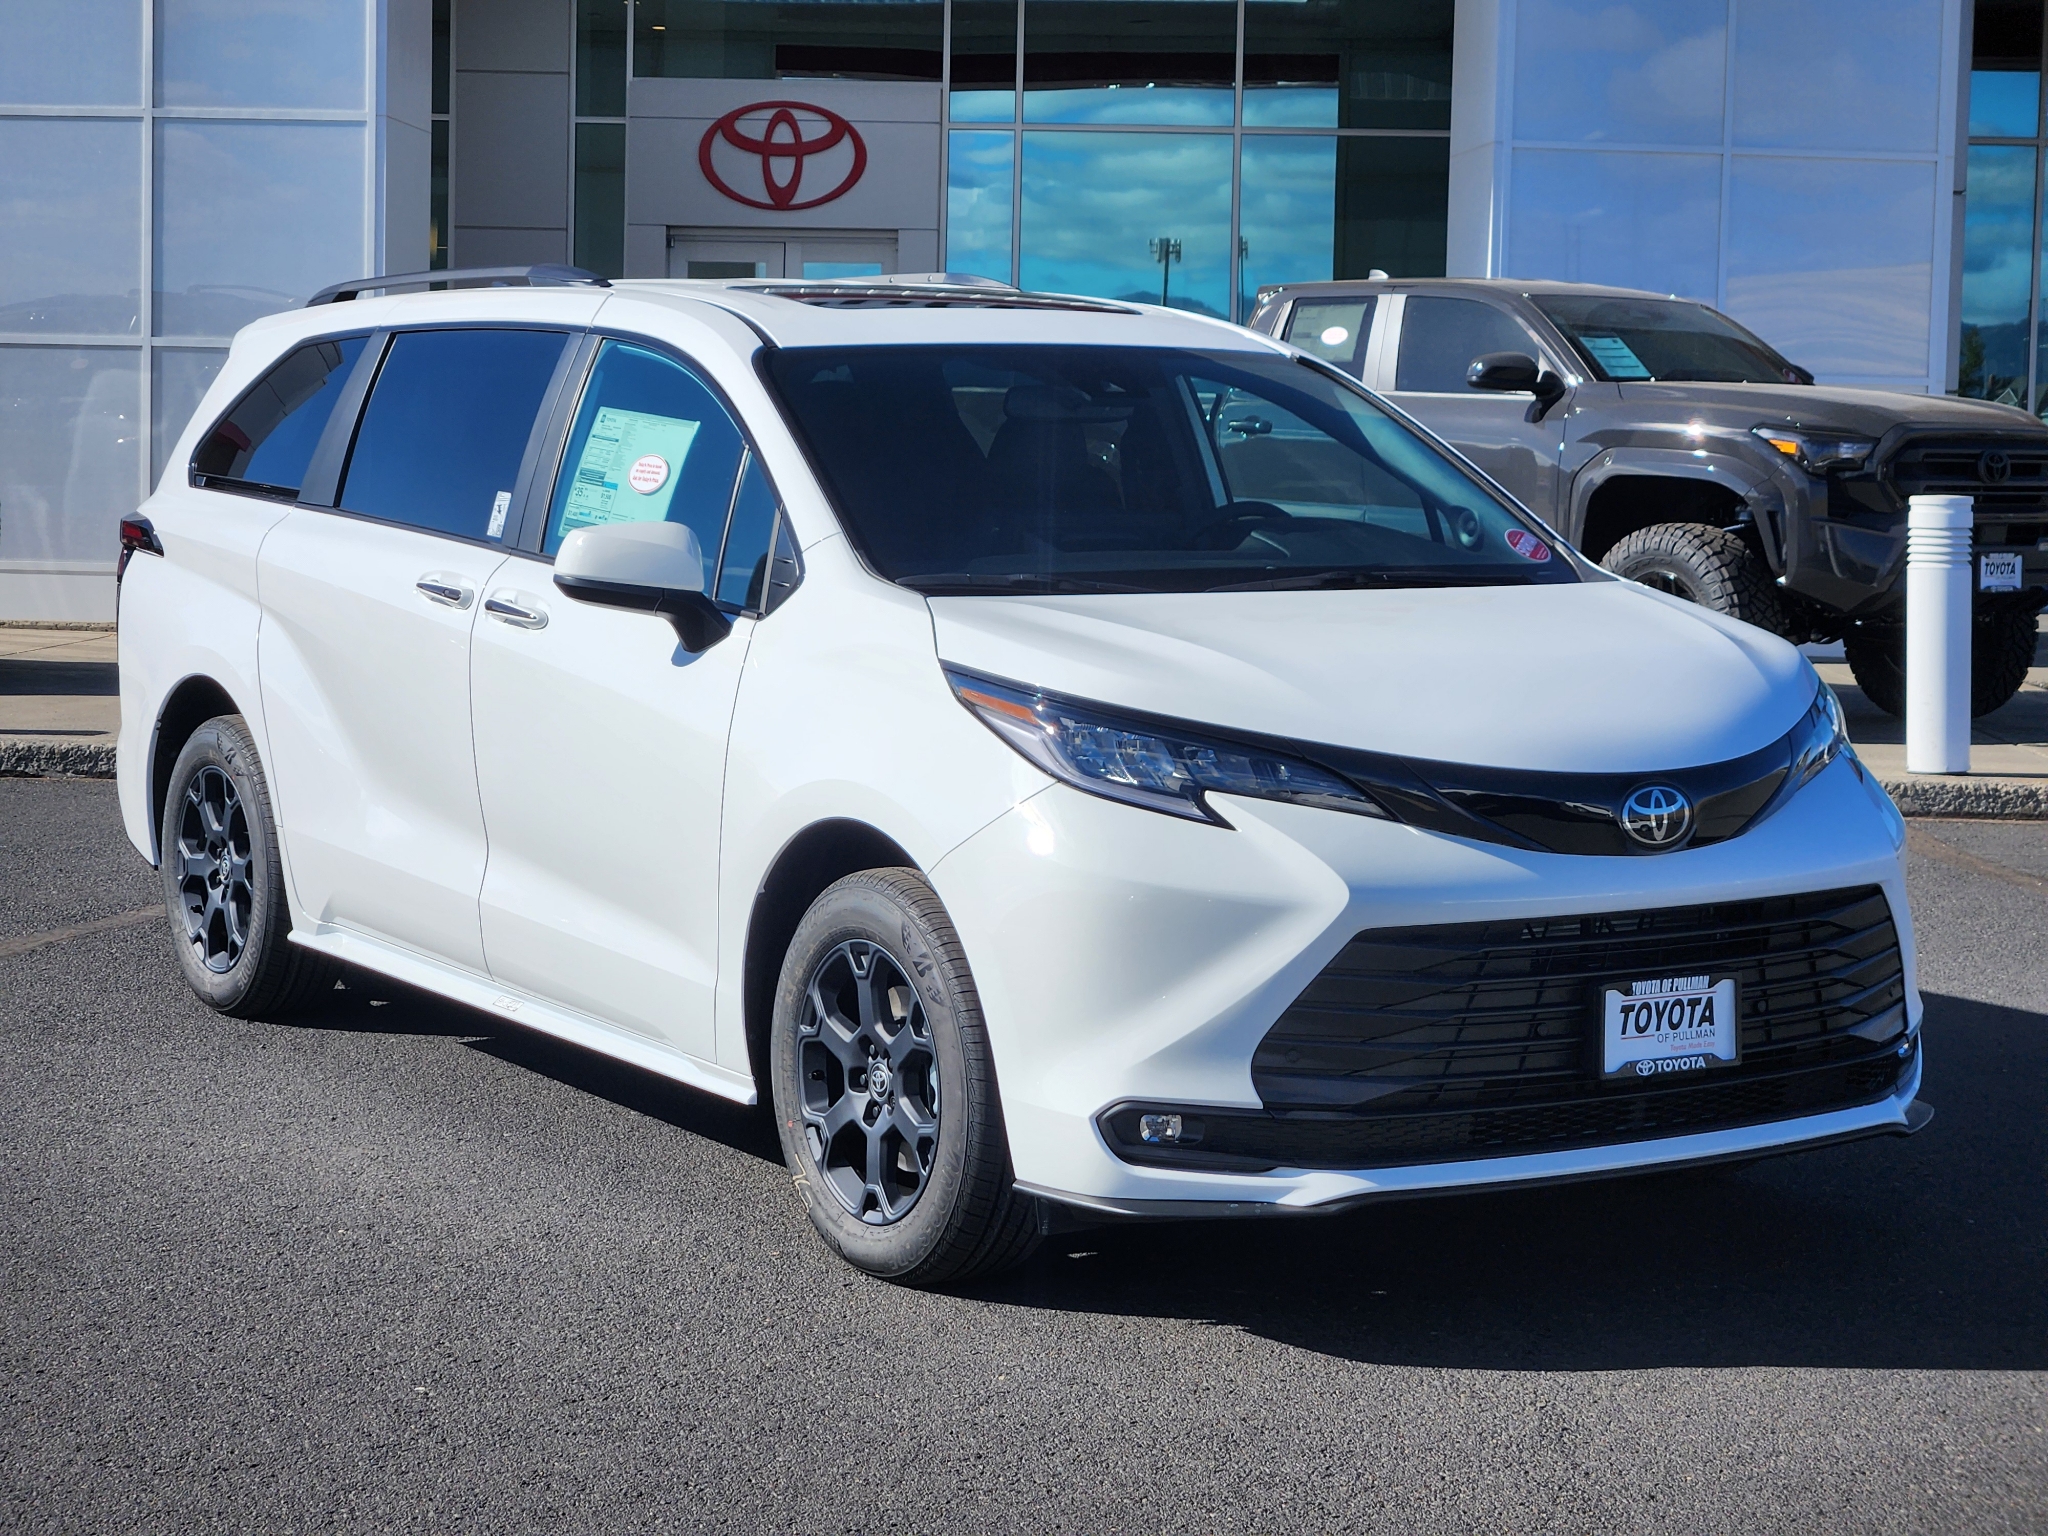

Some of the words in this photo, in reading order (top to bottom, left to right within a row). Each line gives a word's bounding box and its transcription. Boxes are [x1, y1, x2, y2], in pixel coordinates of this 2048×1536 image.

[1985, 561, 2016, 576] TOYOTA
[1632, 980, 1661, 996] TOYOTA
[1661, 978, 1672, 993] OF
[1673, 975, 1710, 991] PULLMAN
[1620, 996, 1715, 1036] TOYOTA
[1657, 1033, 1670, 1043] OF
[1673, 1028, 1716, 1042] PULLMAN
[1656, 1056, 1706, 1073] TOYOTA
